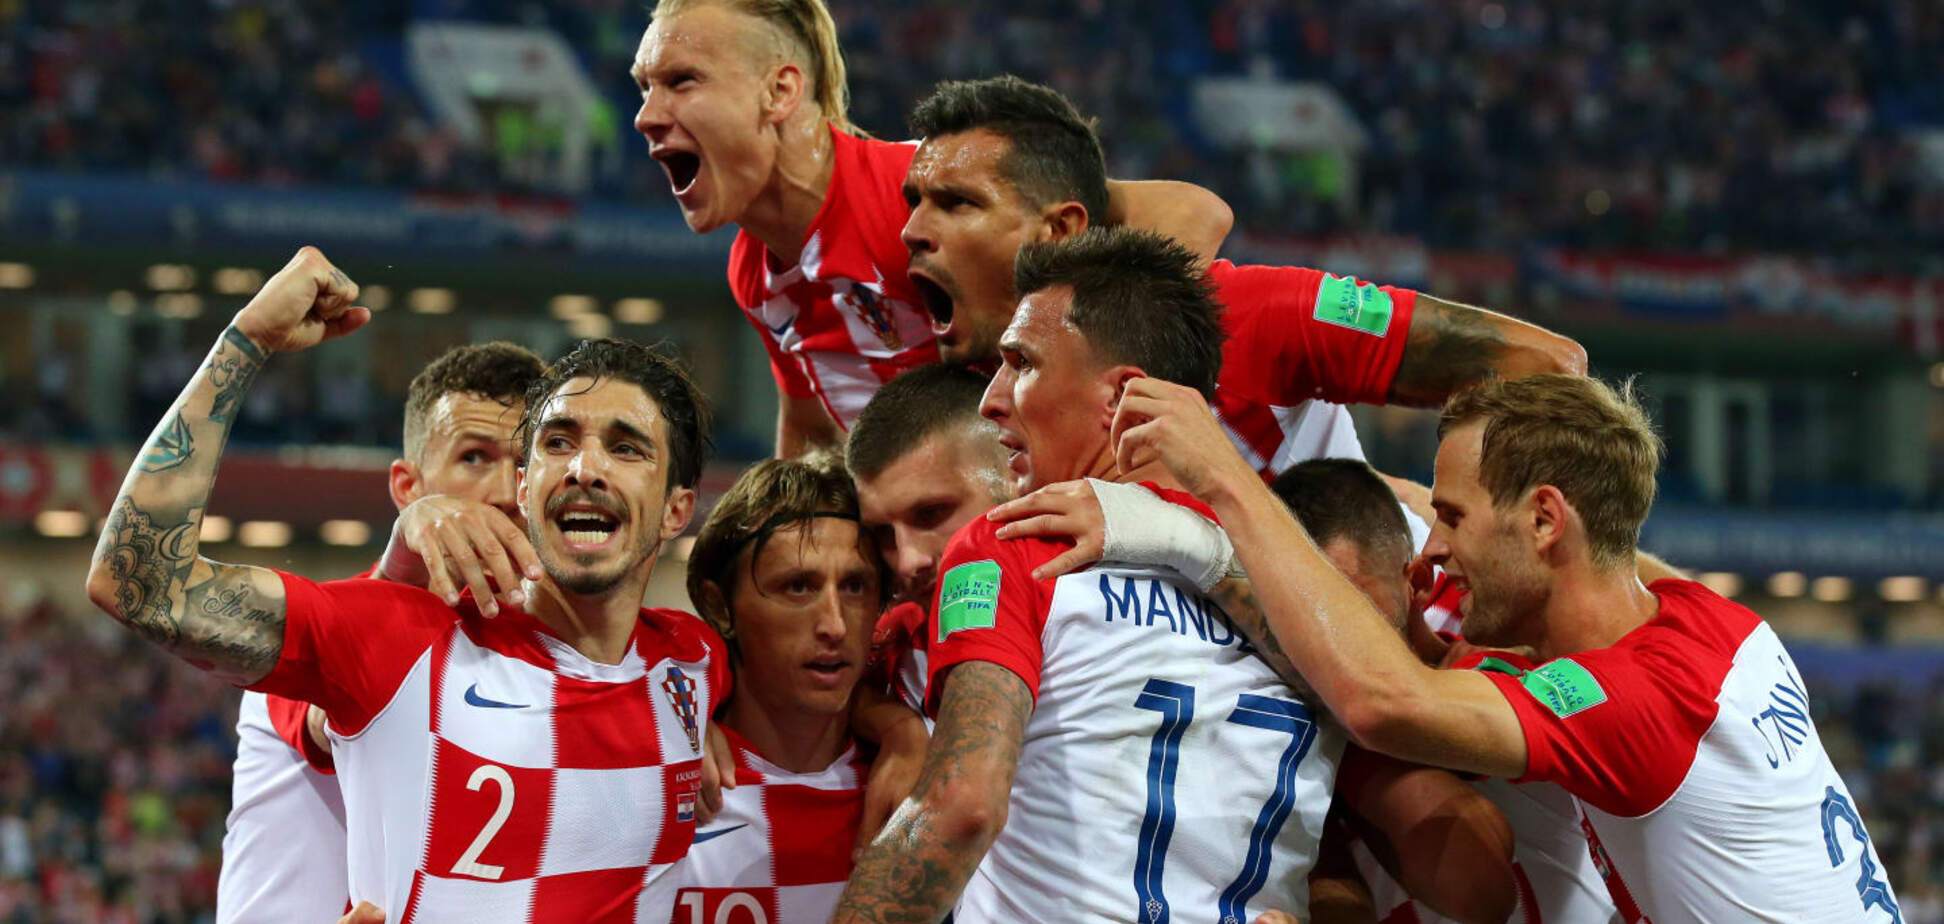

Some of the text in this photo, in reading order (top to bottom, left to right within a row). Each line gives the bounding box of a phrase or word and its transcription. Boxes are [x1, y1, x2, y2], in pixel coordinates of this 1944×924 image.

[967, 602, 990, 610] FIFA
[449, 764, 515, 880] 2
[1134, 678, 1318, 924] 17
